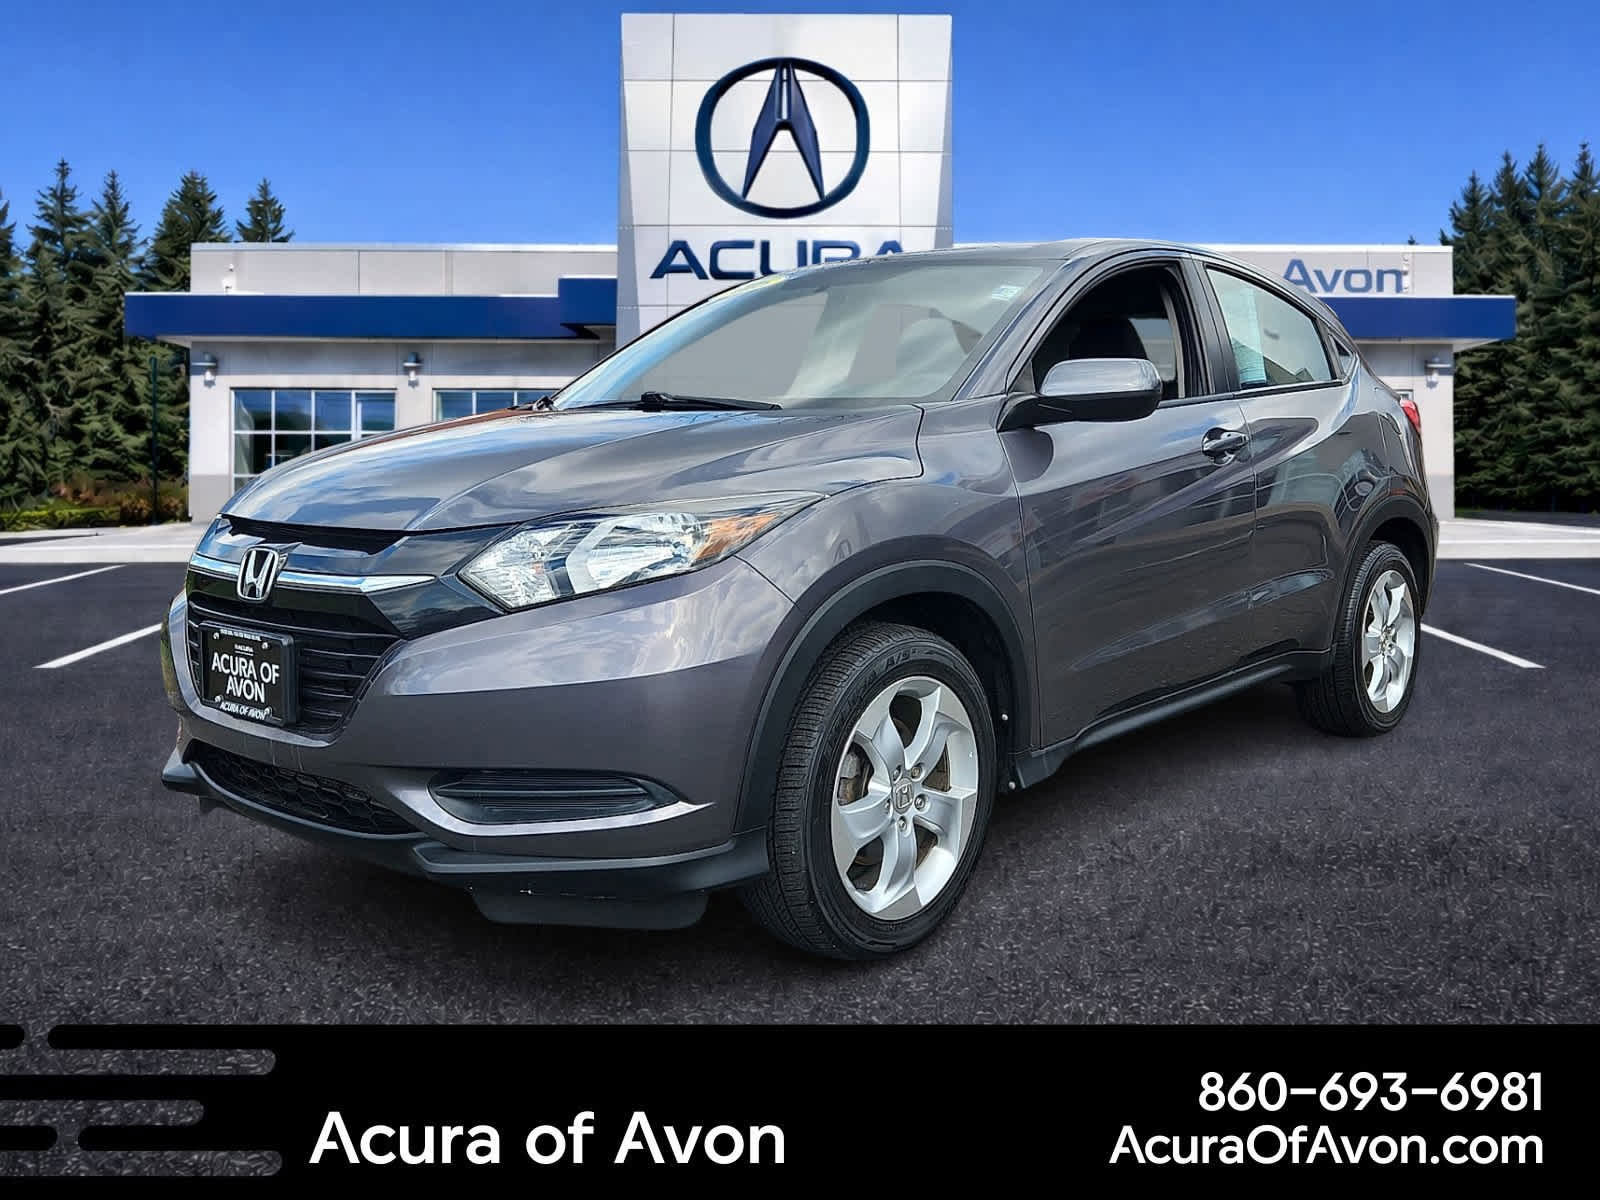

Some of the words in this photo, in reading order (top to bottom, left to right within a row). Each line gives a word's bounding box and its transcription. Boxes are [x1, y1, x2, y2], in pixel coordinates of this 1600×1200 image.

[1284, 259, 1408, 293] Avon
[211, 652, 258, 681] ACURA
[260, 661, 280, 685] OF
[226, 675, 265, 703] AVON
[220, 701, 239, 714] ACURA
[240, 705, 249, 716] OF
[248, 707, 266, 721] AVON
